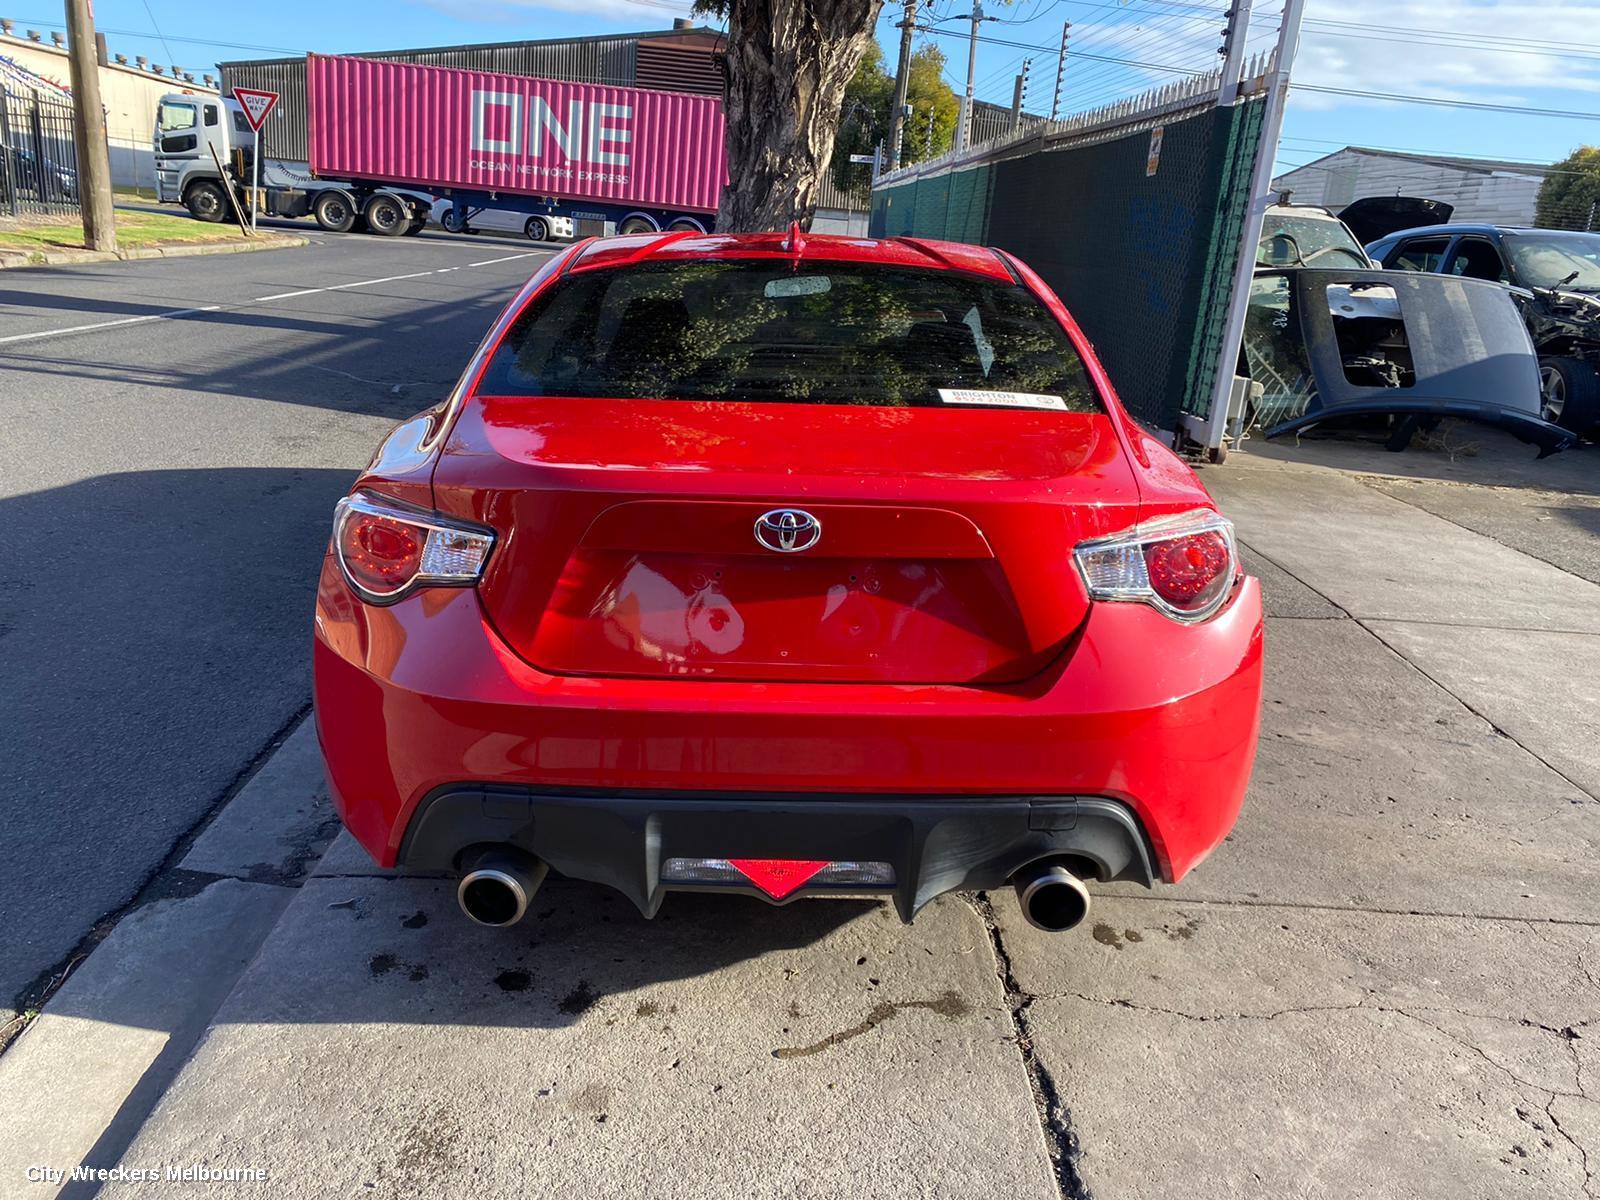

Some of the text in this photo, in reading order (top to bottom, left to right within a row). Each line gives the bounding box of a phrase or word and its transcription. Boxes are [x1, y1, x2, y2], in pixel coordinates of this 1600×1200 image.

[246, 96, 266, 105] GIVE
[471, 90, 632, 166] ONE
[471, 159, 630, 185] OCEAN NETWORK EXPRESS
[952, 390, 1016, 400] BRIGHTON
